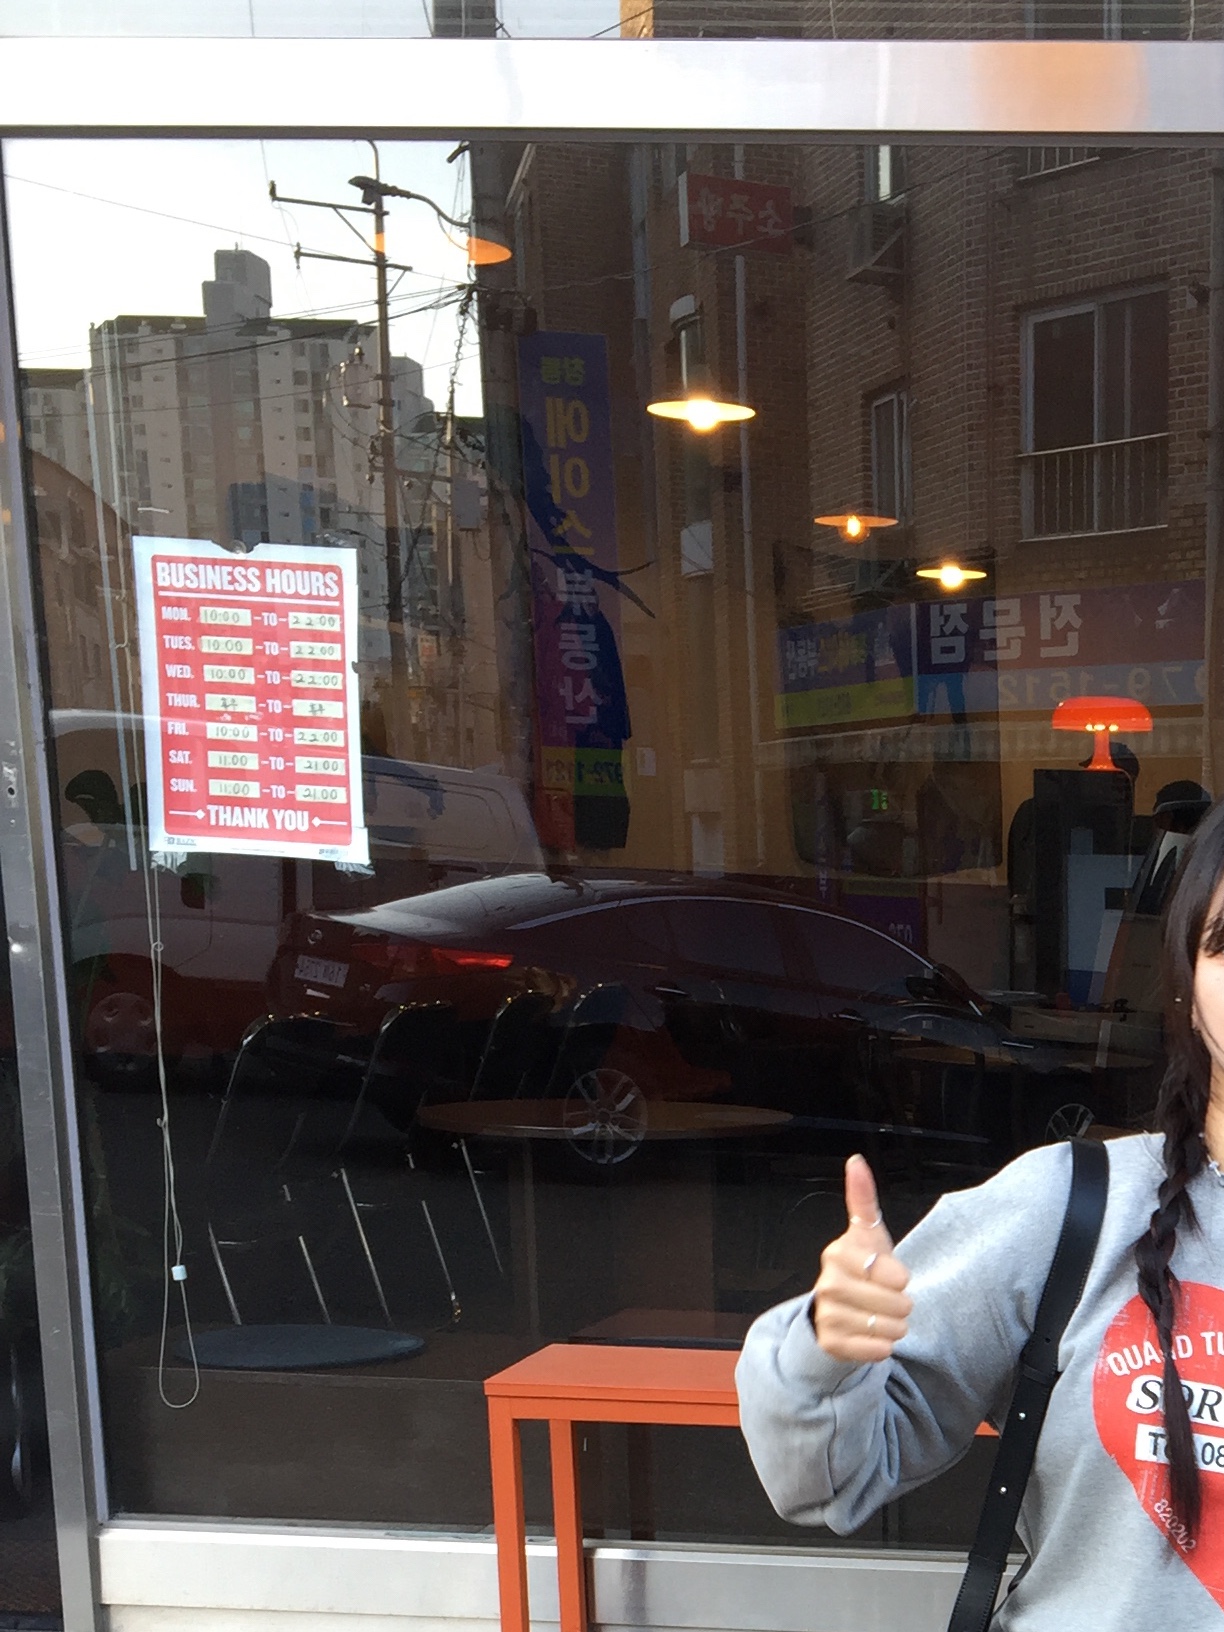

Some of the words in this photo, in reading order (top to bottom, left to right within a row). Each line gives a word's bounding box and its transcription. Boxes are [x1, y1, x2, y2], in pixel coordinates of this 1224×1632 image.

[156, 562, 261, 592] BUSINESS
[265, 568, 340, 598] HOURS
[206, 804, 269, 829] THANK
[273, 809, 310, 832] YOU
[1107, 1334, 1194, 1378] QUAD
